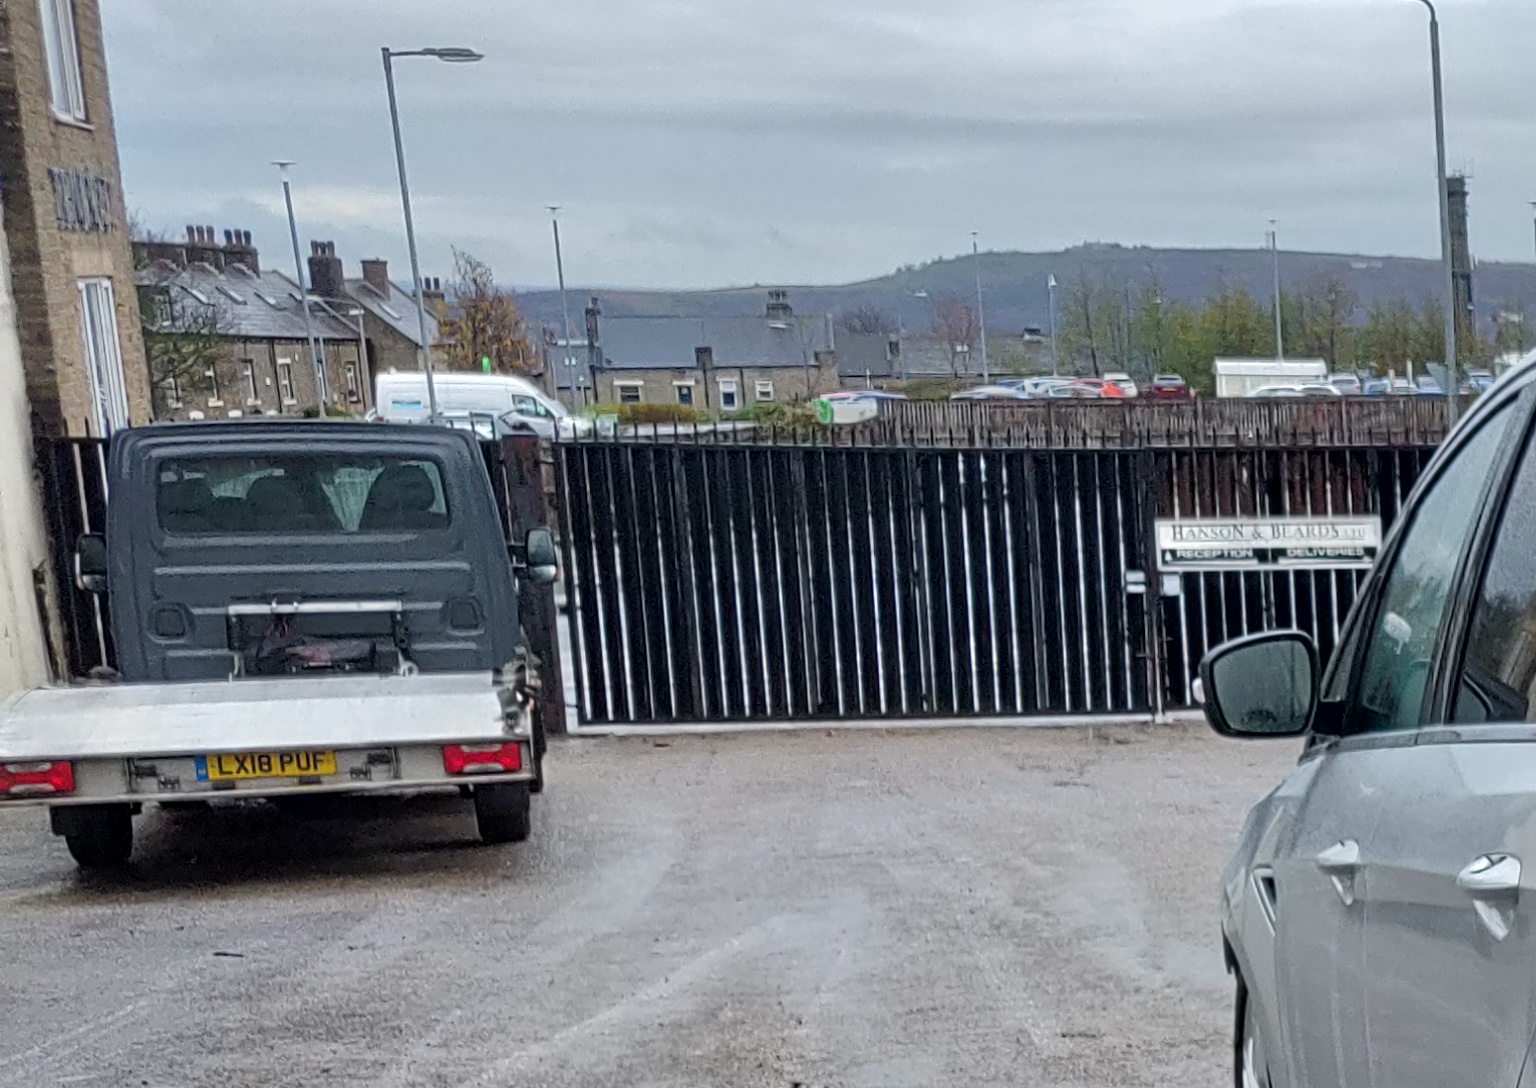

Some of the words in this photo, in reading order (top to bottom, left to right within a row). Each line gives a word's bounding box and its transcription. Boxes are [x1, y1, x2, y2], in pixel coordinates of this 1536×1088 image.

[1172, 524, 1244, 541] HANSON
[1252, 525, 1264, 540] &
[1176, 549, 1253, 559] RECEPTION
[1287, 547, 1364, 558] DELIVERIES
[217, 752, 272, 775] LX18
[280, 750, 326, 773] PUF
